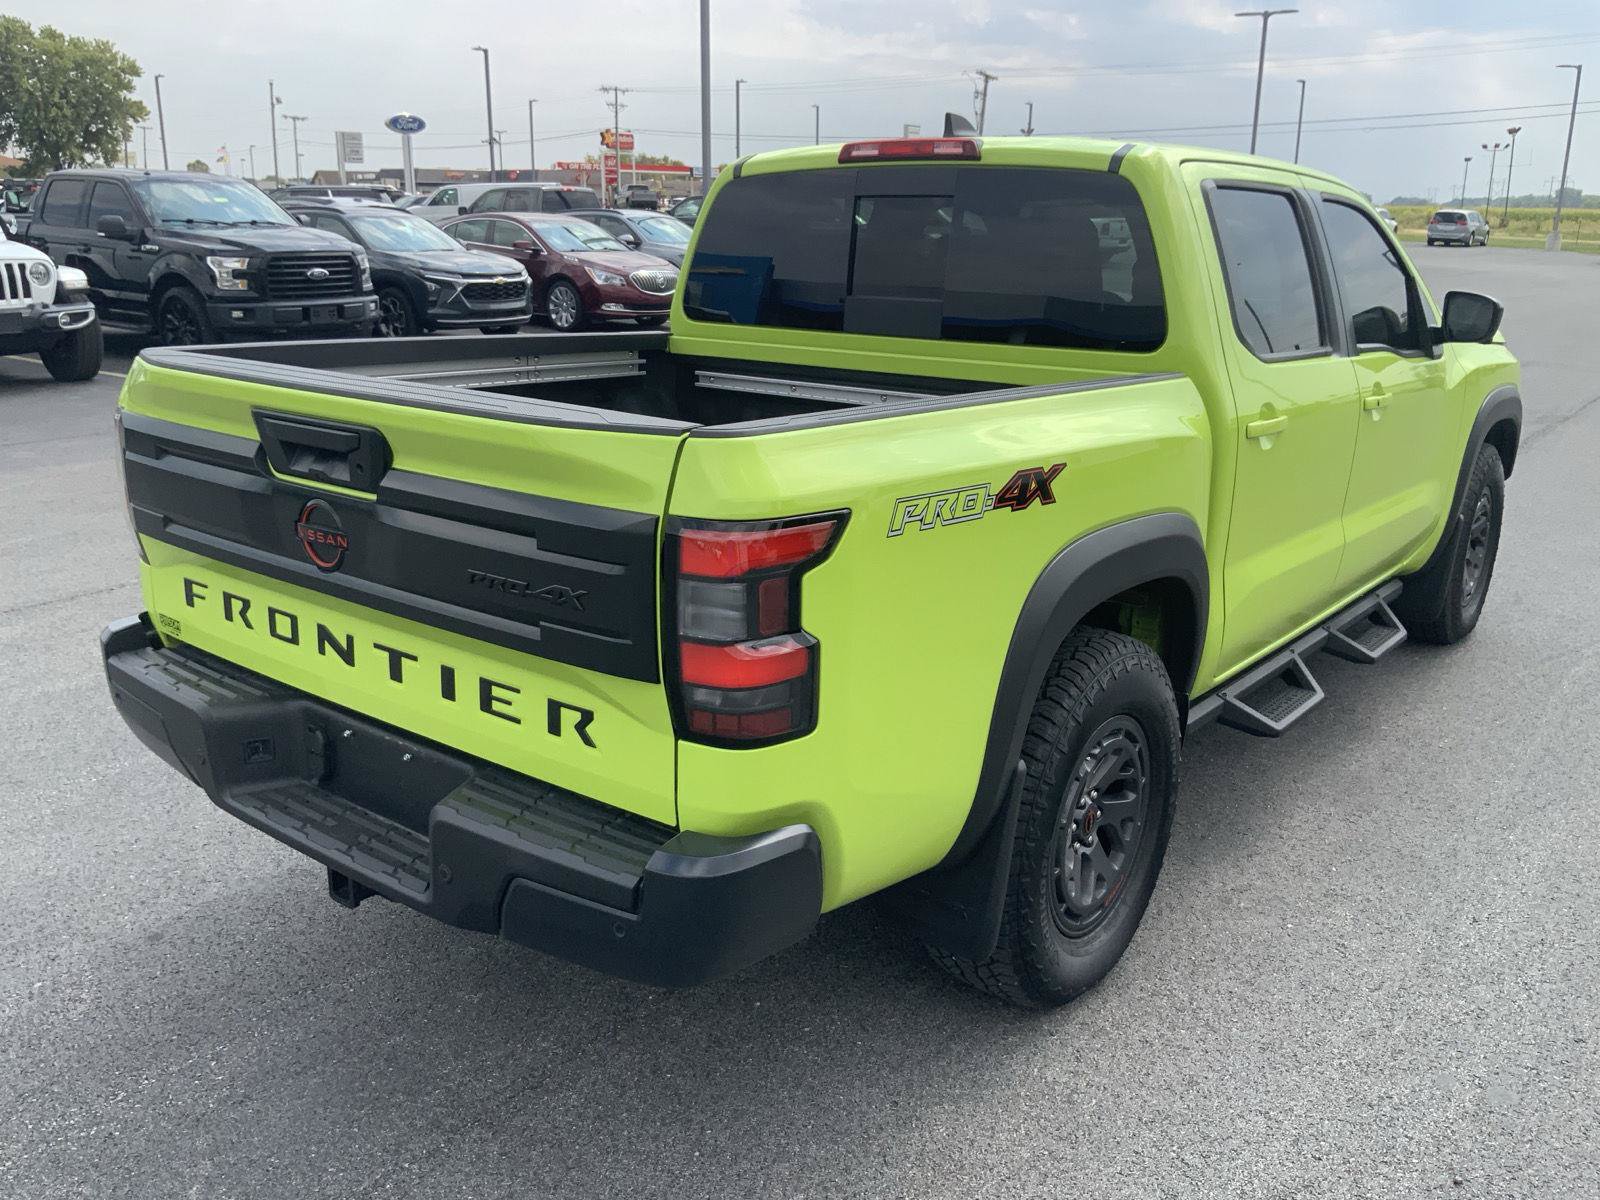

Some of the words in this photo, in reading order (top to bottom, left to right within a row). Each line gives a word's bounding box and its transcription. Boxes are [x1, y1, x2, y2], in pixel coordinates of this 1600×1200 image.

[396, 117, 420, 130] Ford
[887, 463, 1067, 538] PRO-4X
[297, 525, 347, 548] NISSAN
[183, 577, 598, 749] FRONTIER
